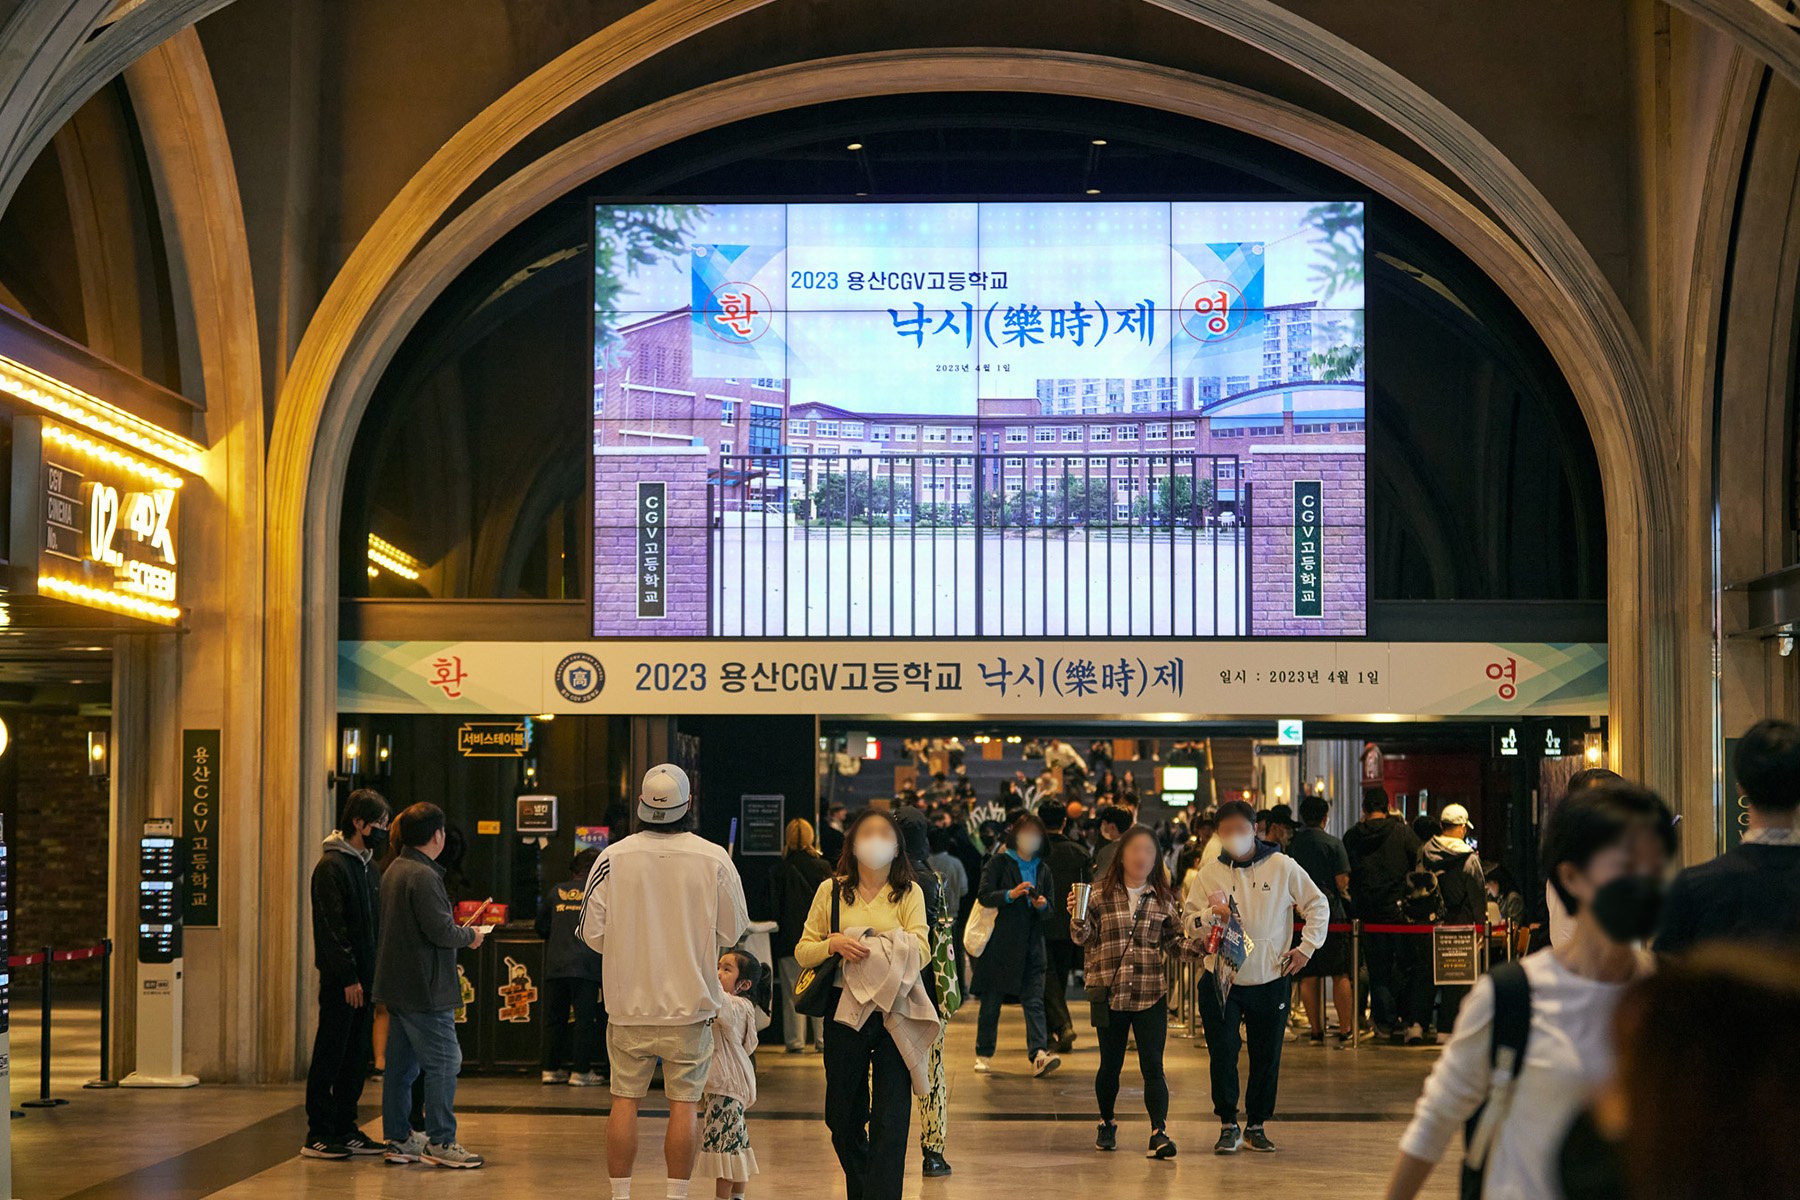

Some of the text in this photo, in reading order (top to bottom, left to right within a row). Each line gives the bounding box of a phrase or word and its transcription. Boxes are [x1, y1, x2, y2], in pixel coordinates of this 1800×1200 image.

[791, 271, 1008, 292] 2023 용산CGV고등학교
[716, 292, 758, 335] 환
[887, 298, 1156, 349] 낙시(樂時)제
[1194, 290, 1230, 333] 영
[936, 363, 969, 373] 2023년
[975, 363, 990, 373] 4월
[48, 467, 63, 493] CGV
[48, 497, 73, 526] CINEMA
[644, 495, 660, 604] CGV고등학교
[1300, 495, 1318, 603] CGV고등학교
[128, 559, 176, 602] SCREEN
[430, 655, 468, 698] 환
[635, 656, 1184, 698] 2023 용산CGV고등학교 낙시(樂時)제
[1219, 669, 1247, 685] 일시
[1269, 669, 1320, 685] 2023년
[1327, 669, 1349, 685] 4월
[1357, 669, 1379, 685] 1일
[1486, 656, 1517, 700] 영
[463, 732, 524, 746] 서비스테이블
[191, 746, 211, 907] 용산CGV고등학교
